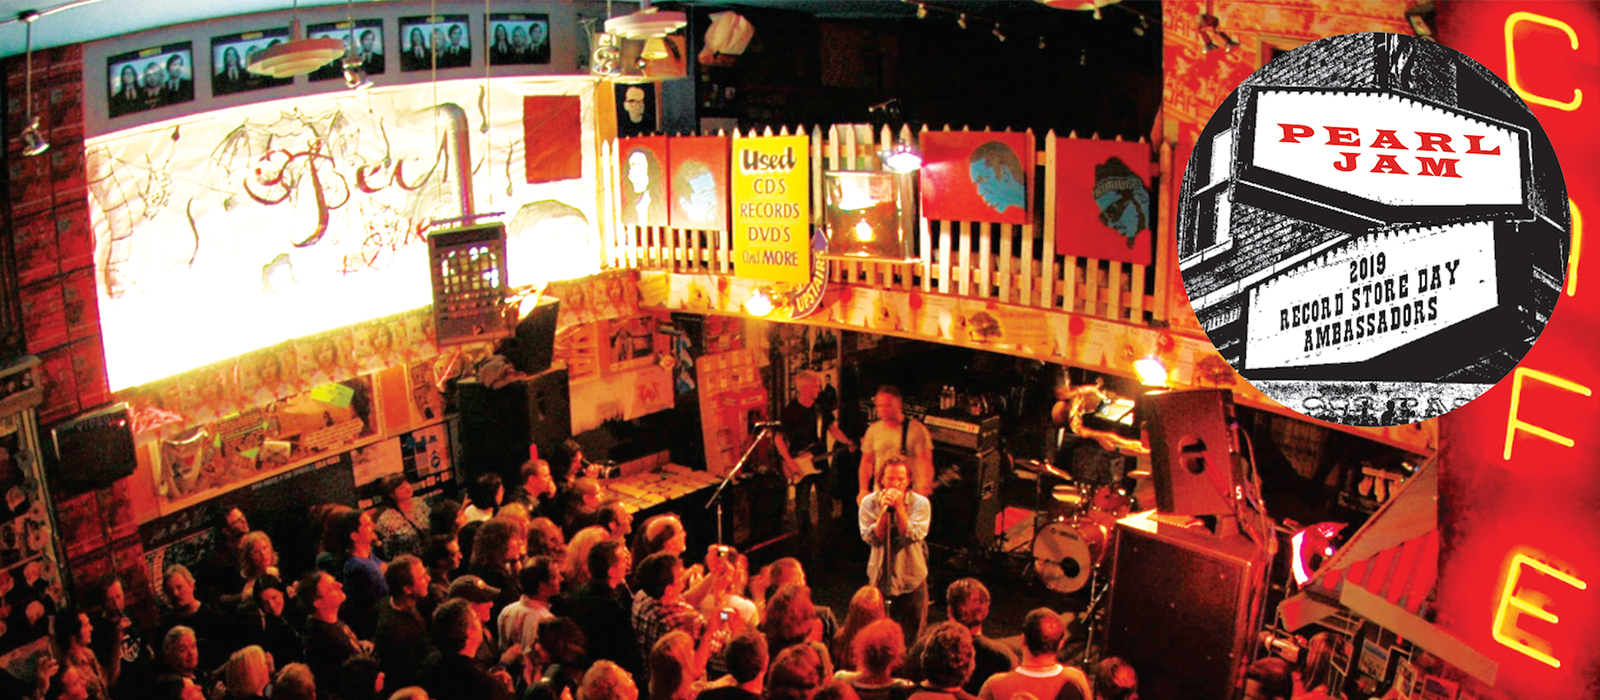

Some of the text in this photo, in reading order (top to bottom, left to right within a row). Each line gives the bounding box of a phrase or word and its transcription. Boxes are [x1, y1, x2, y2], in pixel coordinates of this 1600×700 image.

[742, 146, 797, 171] Used
[740, 202, 800, 219] RECORDS
[762, 250, 799, 267] MORE
[796, 249, 826, 313] UPSTAIRS
